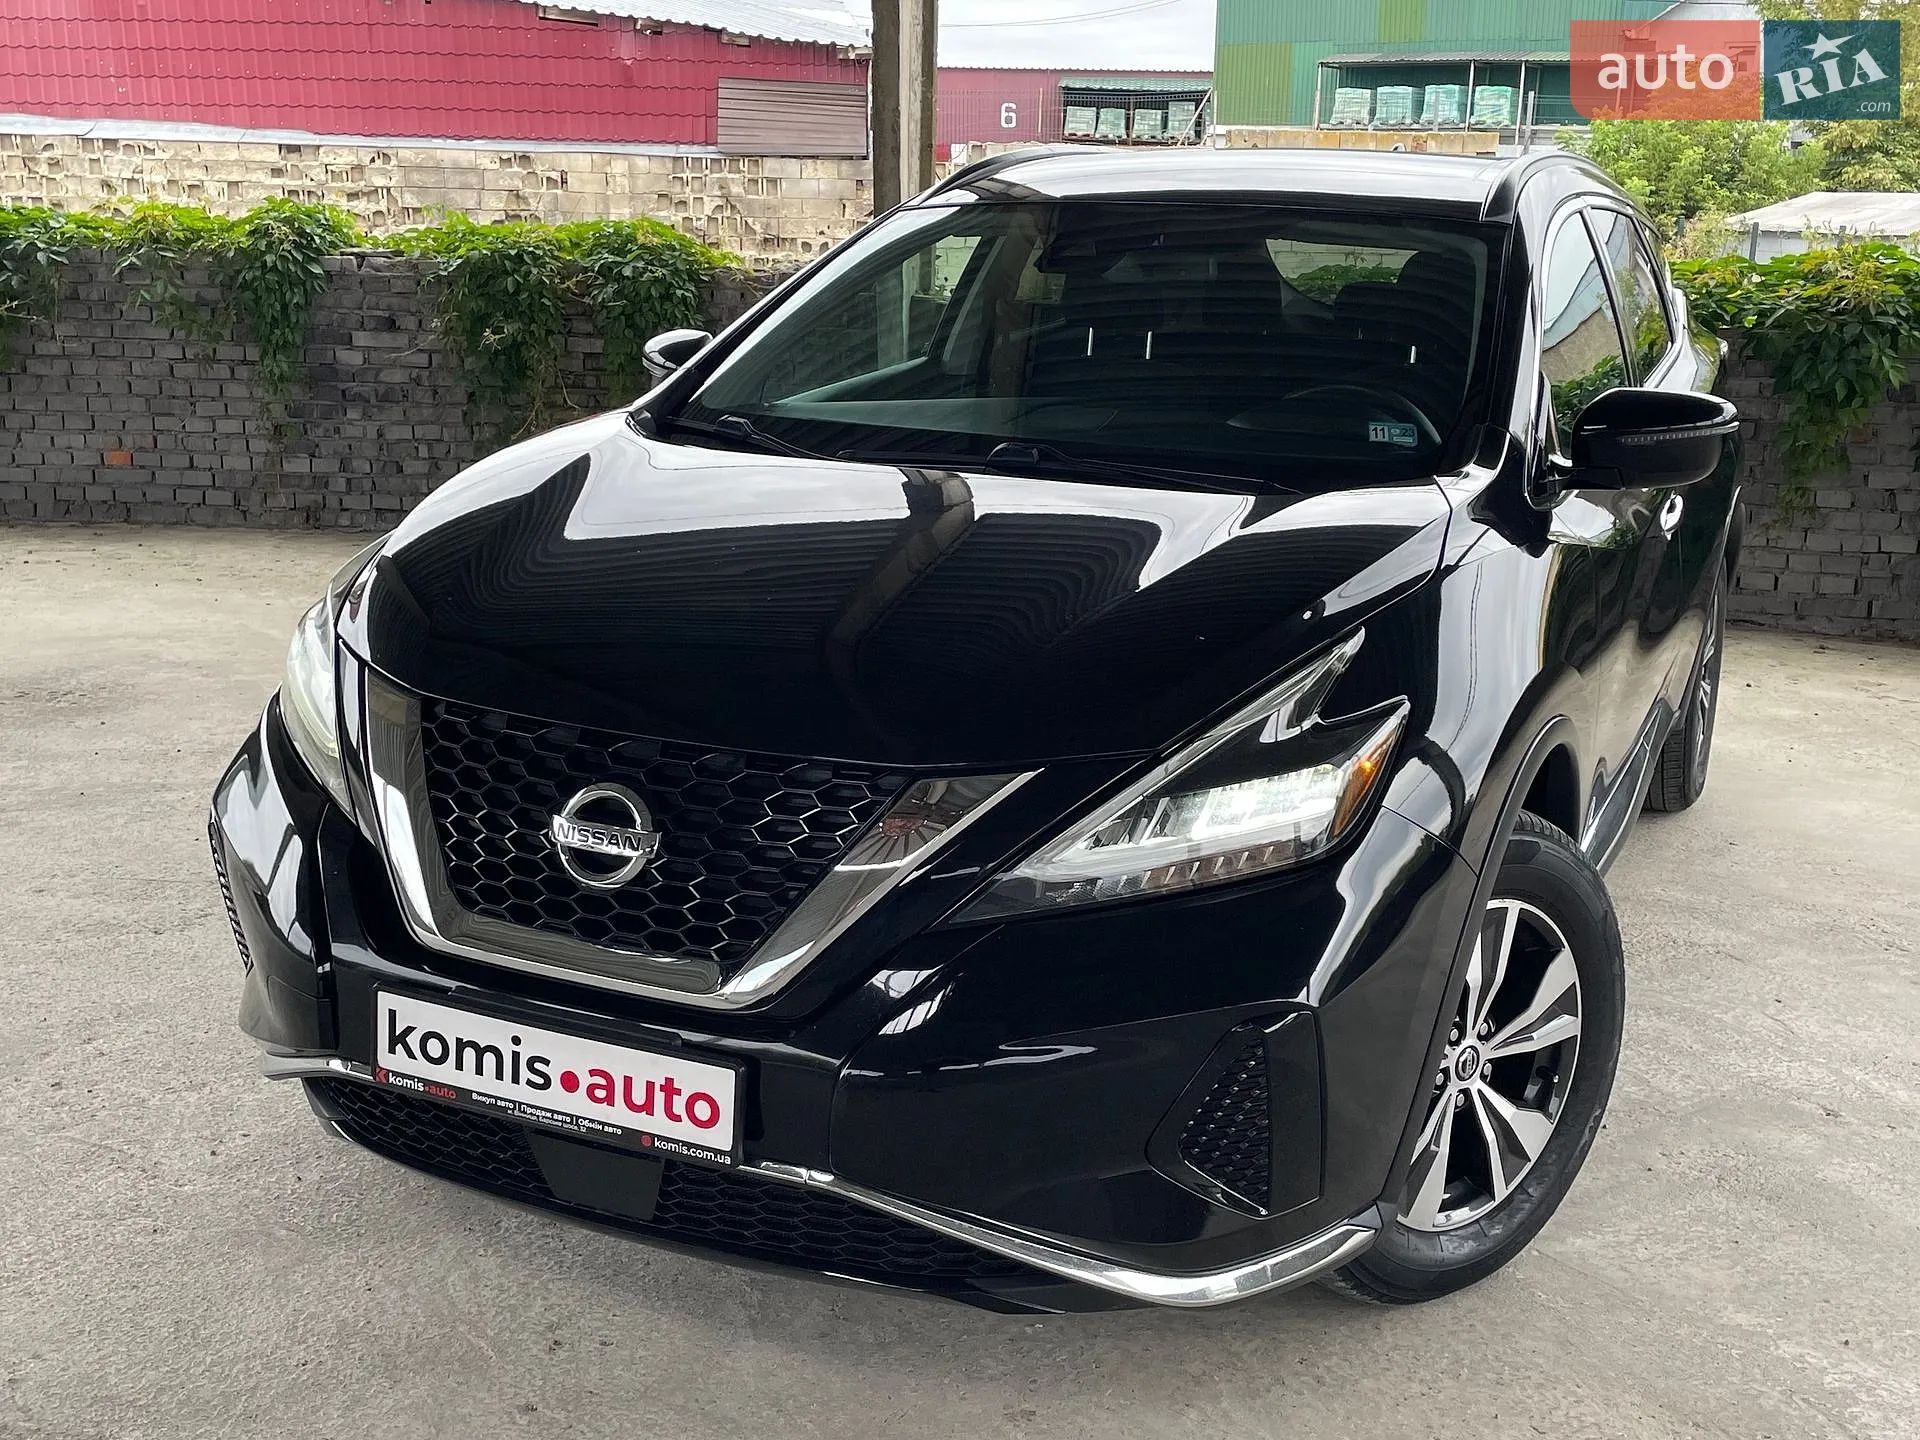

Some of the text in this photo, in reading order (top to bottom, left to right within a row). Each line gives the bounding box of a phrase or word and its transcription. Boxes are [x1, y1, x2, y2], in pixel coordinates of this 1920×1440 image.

[1000, 102, 1018, 129] 6
[1371, 426, 1387, 440] 11
[556, 822, 643, 852] NISSAN
[496, 1100, 514, 1109] авто
[553, 1113, 571, 1123] авто
[603, 1125, 623, 1136] авто
[654, 1136, 731, 1165] komis.com.ua
